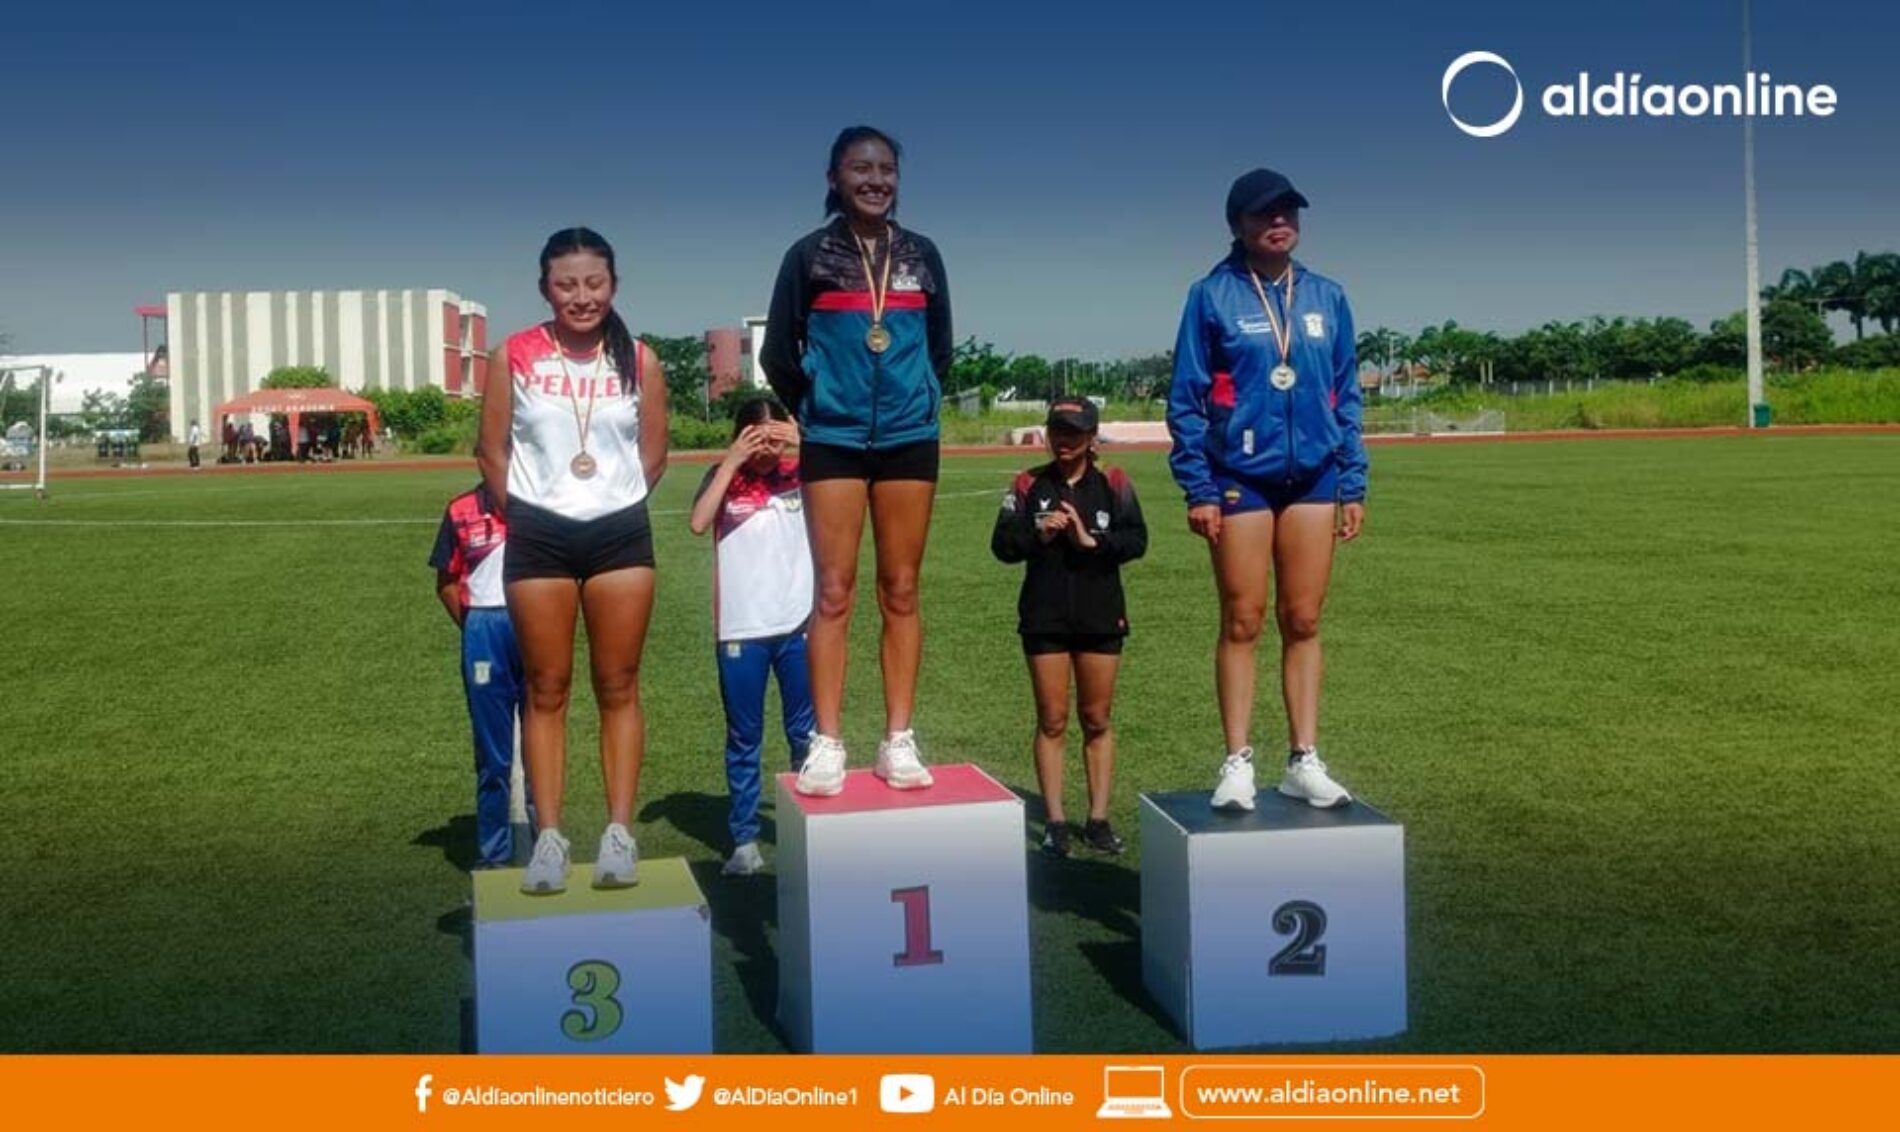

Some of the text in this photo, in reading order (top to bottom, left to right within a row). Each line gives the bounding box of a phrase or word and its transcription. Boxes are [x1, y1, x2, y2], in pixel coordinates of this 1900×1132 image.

[890, 885, 944, 968] 1
[1268, 899, 1328, 976] 2
[560, 959, 624, 1041] 3
